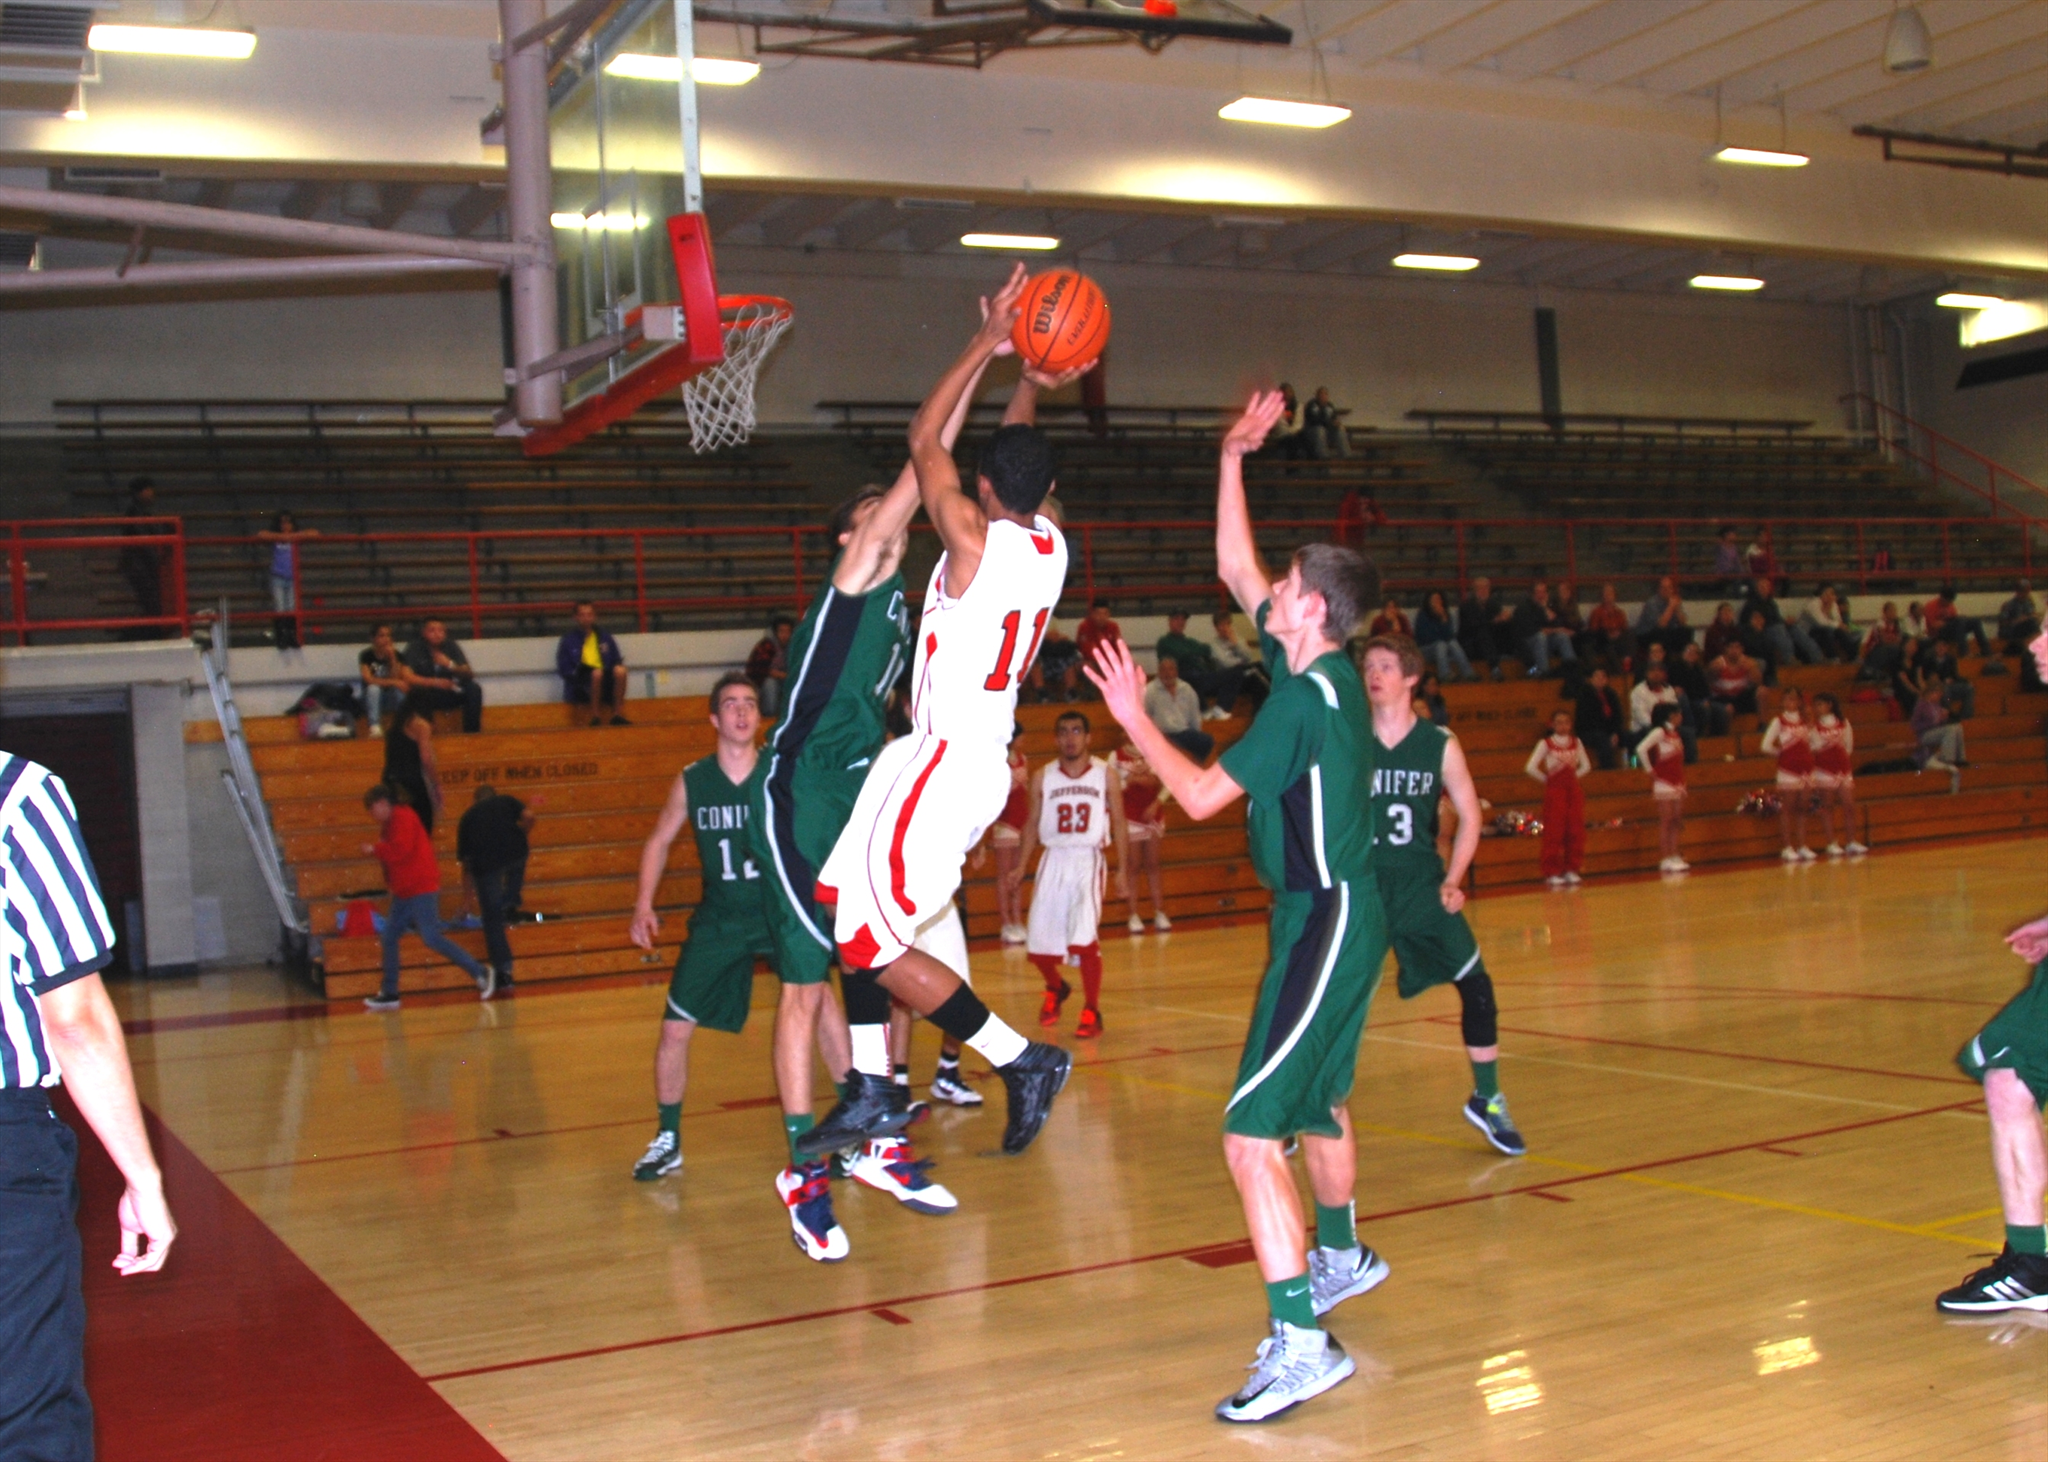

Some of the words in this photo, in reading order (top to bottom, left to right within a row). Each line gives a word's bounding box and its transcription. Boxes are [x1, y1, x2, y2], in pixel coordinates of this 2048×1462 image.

[1033, 275, 1071, 334] Wilson
[983, 606, 1051, 691] 11
[438, 768, 469, 784] EEP
[505, 764, 542, 780] WHEN
[546, 762, 598, 778] CLOSED
[1370, 768, 1434, 797] NIFER
[1057, 803, 1091, 833] 23
